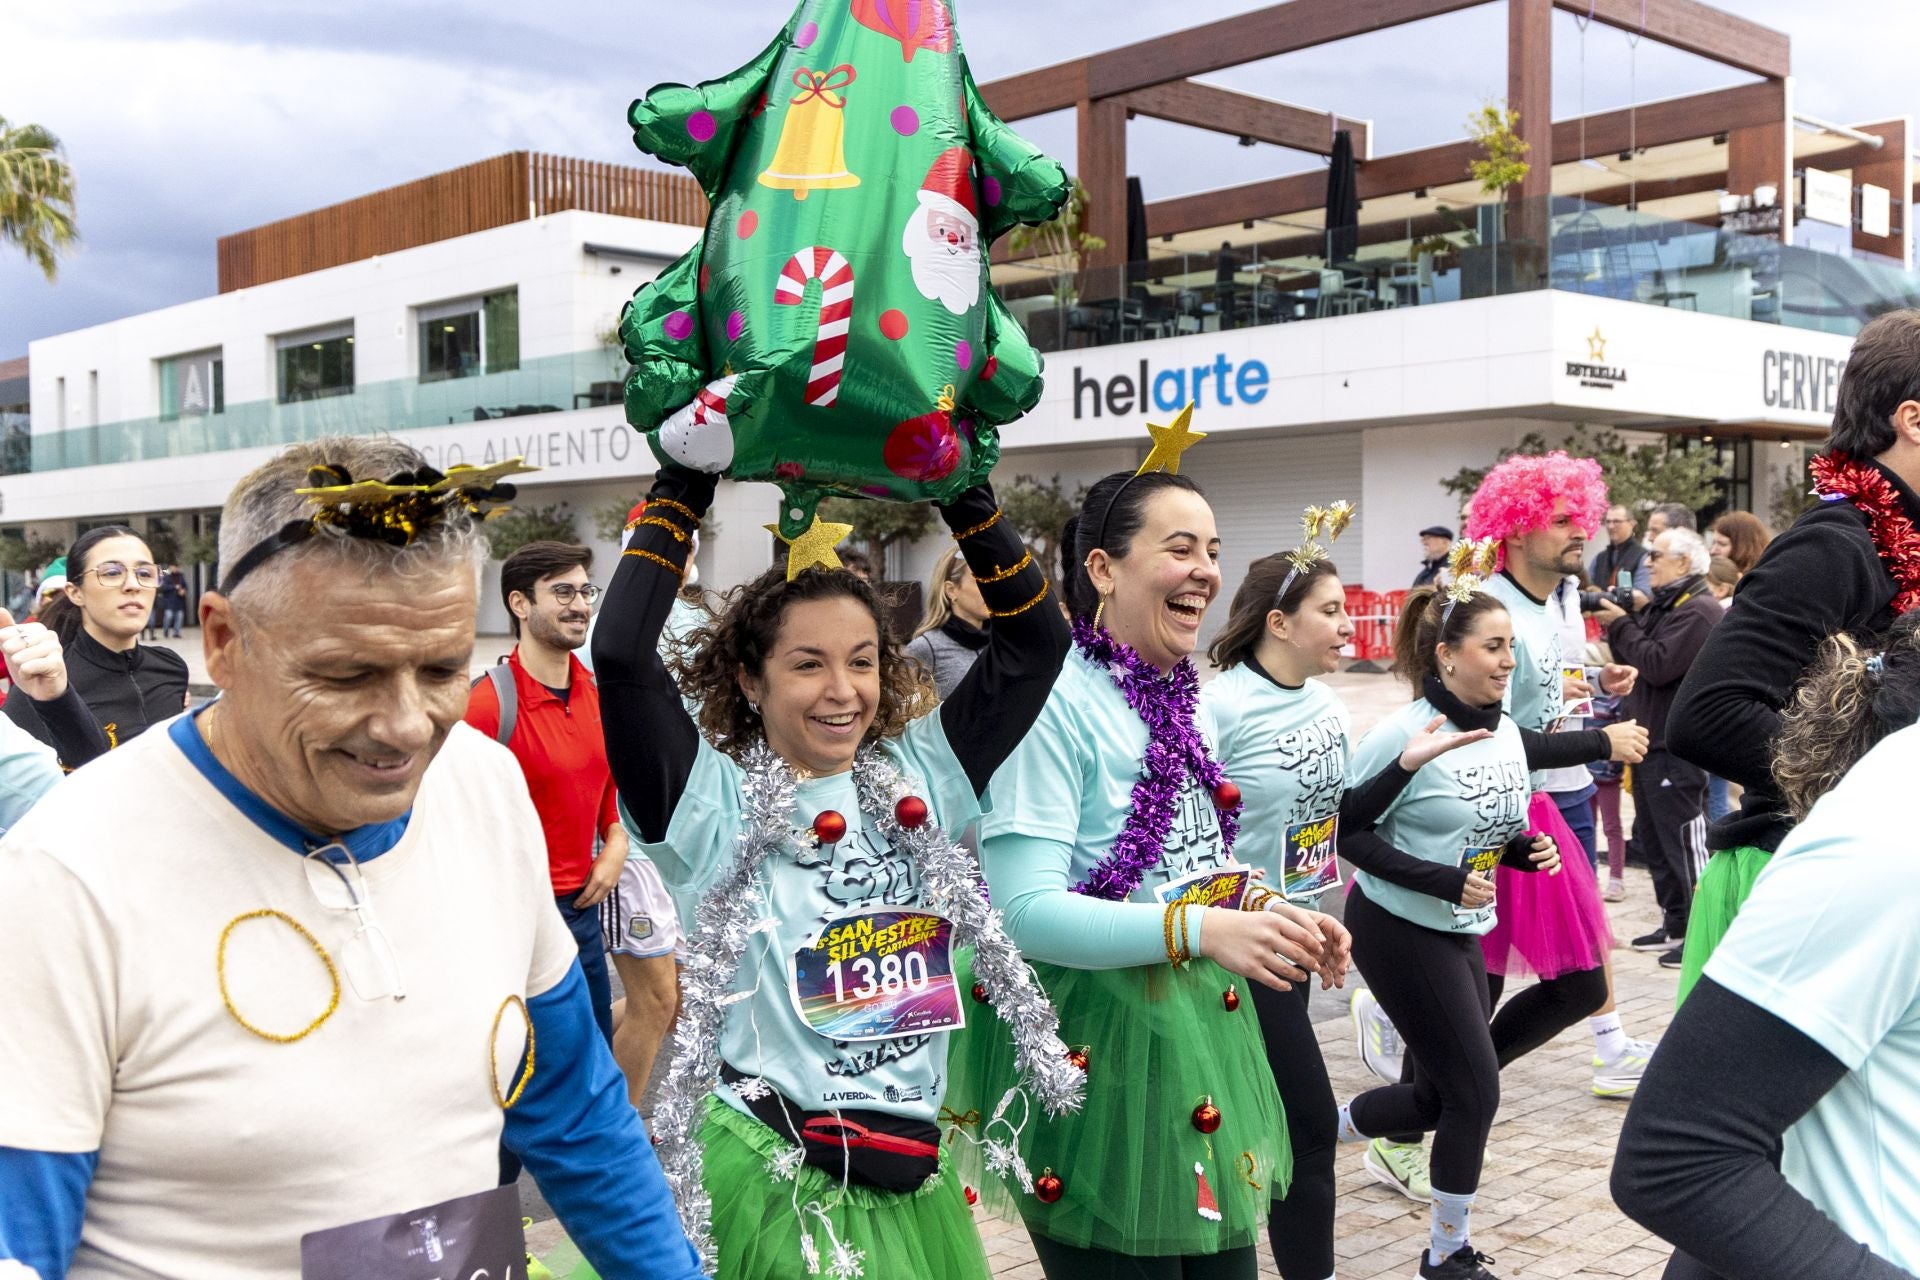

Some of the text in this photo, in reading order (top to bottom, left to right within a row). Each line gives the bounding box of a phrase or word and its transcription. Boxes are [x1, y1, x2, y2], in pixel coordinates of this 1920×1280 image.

[1073, 353, 1270, 419] helarte
[483, 424, 631, 471] ALVIENTO
[1296, 840, 1330, 872] 2477
[828, 917, 874, 946] SAN
[828, 918, 940, 966] SILVESTRE
[878, 931, 937, 957] CARTAGENA
[826, 951, 929, 1002] 1380
[823, 1093, 839, 1101] LA
